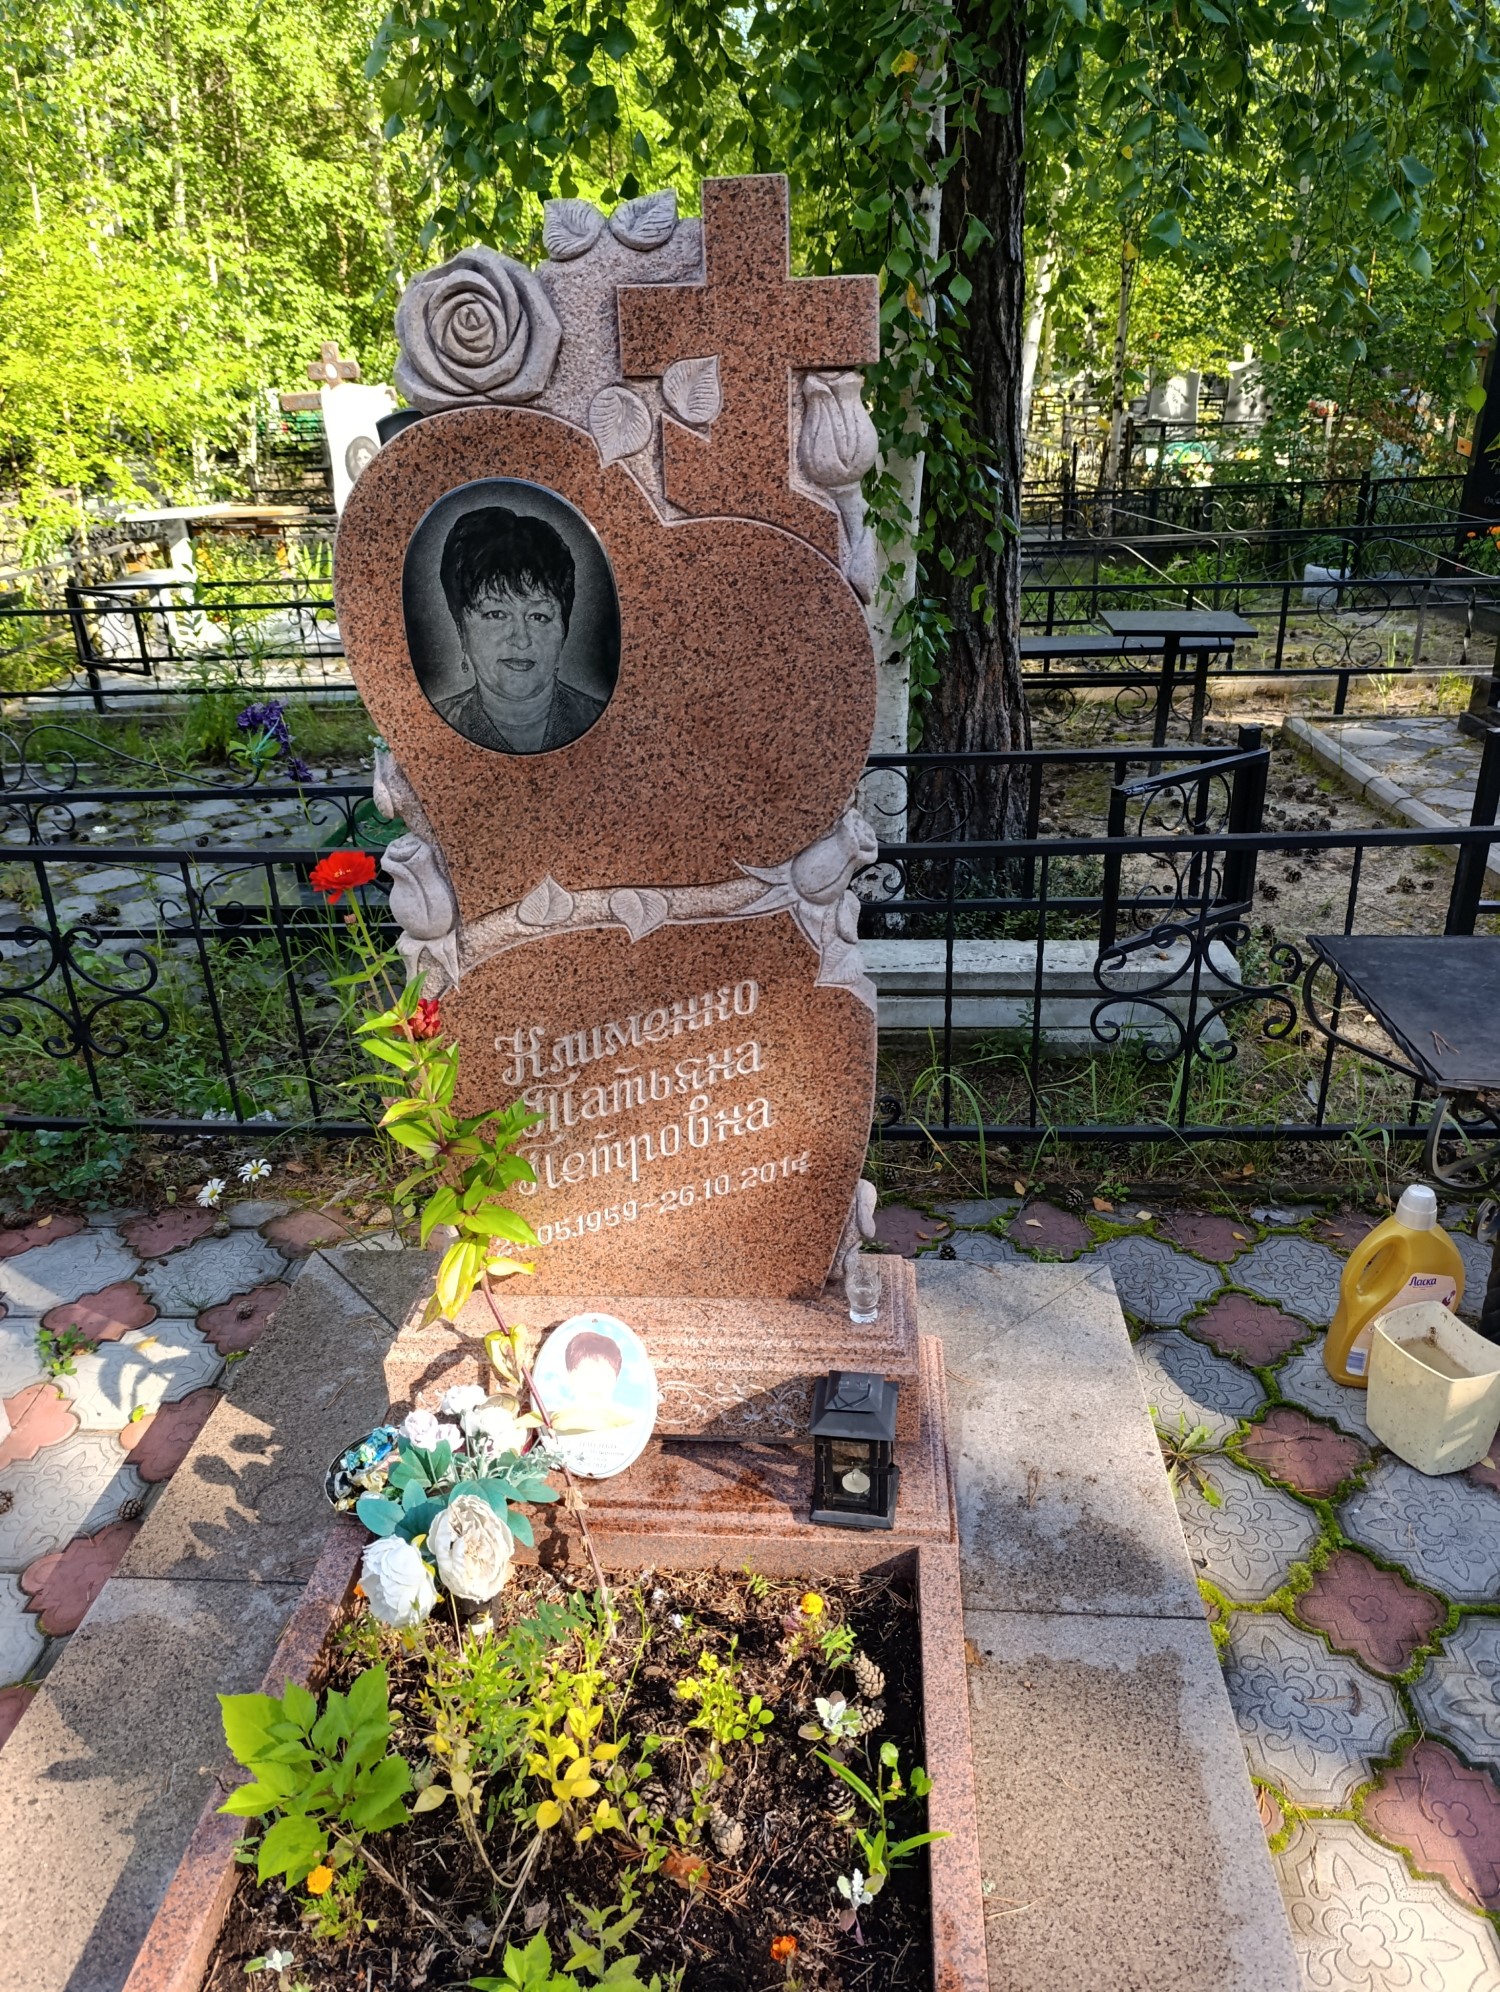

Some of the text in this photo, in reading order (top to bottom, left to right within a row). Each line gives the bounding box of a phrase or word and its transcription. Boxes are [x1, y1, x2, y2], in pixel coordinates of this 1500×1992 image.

[495, 979, 759, 1086] Клименко
[521, 1040, 765, 1138] Татьяна
[516, 1094, 776, 1195] Петровна
[1409, 1276, 1437, 1287] Ласка
